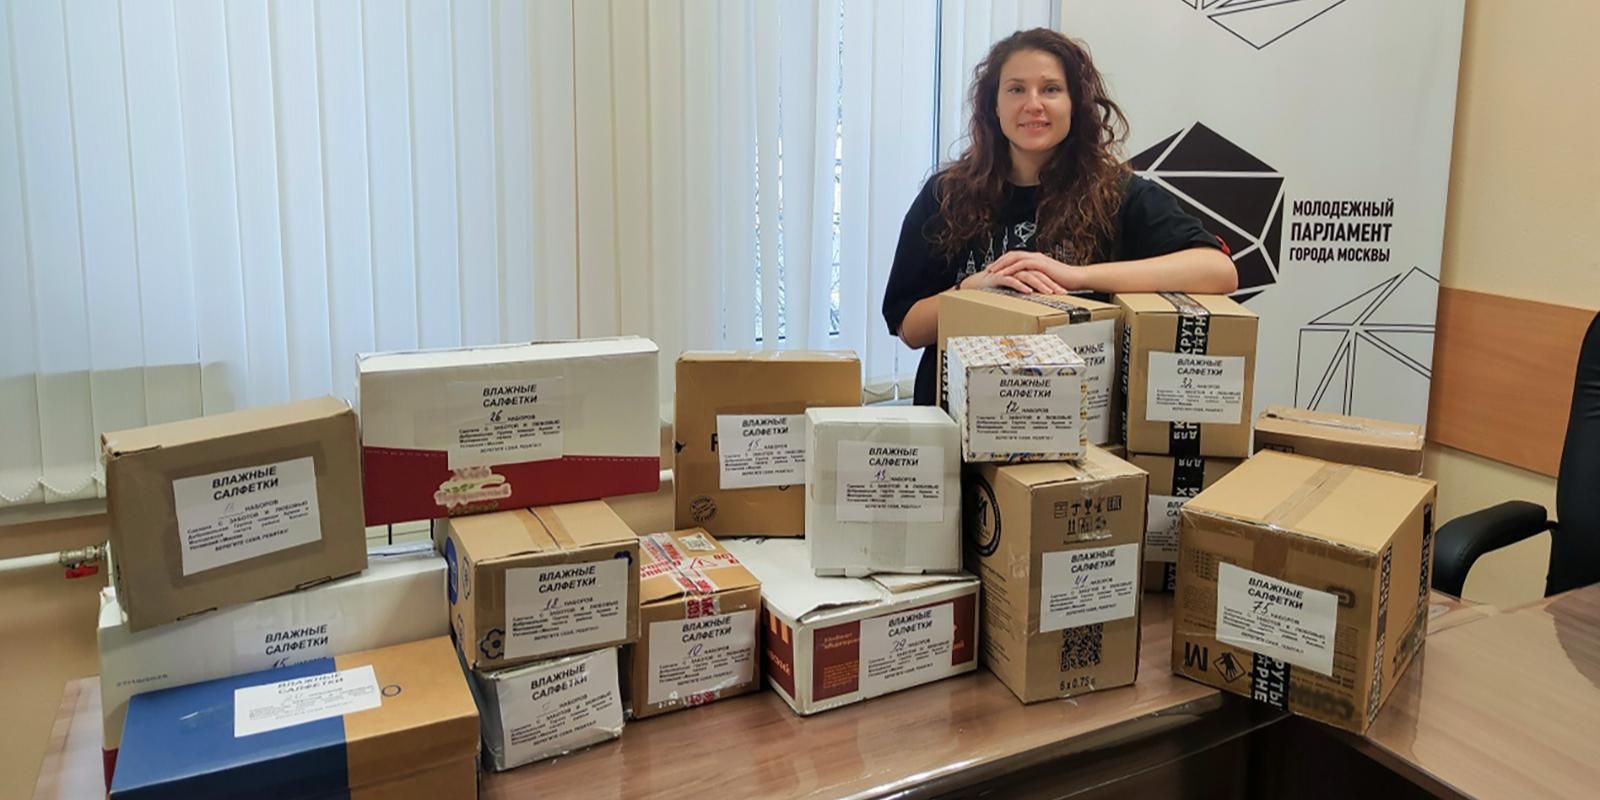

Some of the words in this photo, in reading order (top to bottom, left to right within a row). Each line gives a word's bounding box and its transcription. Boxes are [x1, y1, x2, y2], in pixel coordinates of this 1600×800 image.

[1292, 198, 1394, 218] МОЛОДЕЖНЫЙ
[1291, 222, 1392, 242] ПАРЛАМЕНТ
[1290, 248, 1334, 263] ГОРОДА
[1337, 248, 1390, 262] МОСКВЫ
[1177, 368, 1223, 376] САЛФЕТКИ
[483, 384, 537, 397] ВЛАЖНЫЕ
[1000, 390, 1052, 398] САЛФЕТКИ
[483, 395, 538, 408] САЛФЕТКИ
[1006, 400, 1019, 414] 12
[490, 410, 503, 422] 26
[742, 418, 786, 428] ВЛАЖНЫЕ
[743, 427, 788, 437] САЛФЕТКИ
[869, 448, 918, 456] ВЛАЖНЫЕ
[869, 458, 919, 466] САЛФЕТКИ
[212, 466, 277, 489] ВЛАЖНЫЕ
[214, 478, 279, 501] САЛФЕТКИ
[244, 499, 278, 511] НАБОРОВ
[1071, 549, 1115, 563] ВЛАЖНЫЕ
[538, 566, 596, 582] ВЛАЖНЫЕ
[1071, 560, 1116, 573] САЛФЕТКИ
[538, 578, 596, 593] САЛФЕТКИ
[1248, 578, 1304, 599] ВЛАЖНЫЕ
[1248, 588, 1303, 610] САЛФЕТКИ
[1252, 601, 1274, 614] 75
[682, 616, 731, 632] ВЛАЖНЫЕ
[888, 610, 932, 628] ВЛАЖНЫЕ
[265, 624, 327, 643] ВЛАЖНЫЕ
[682, 627, 732, 643] САЛФЕТКИ
[888, 621, 932, 637] САЛФЕТКИ
[265, 636, 328, 655] САЛФЕТКИ
[531, 664, 586, 690] ВЛАЖНЫЕ
[532, 675, 587, 701] САЛФЕТКИ
